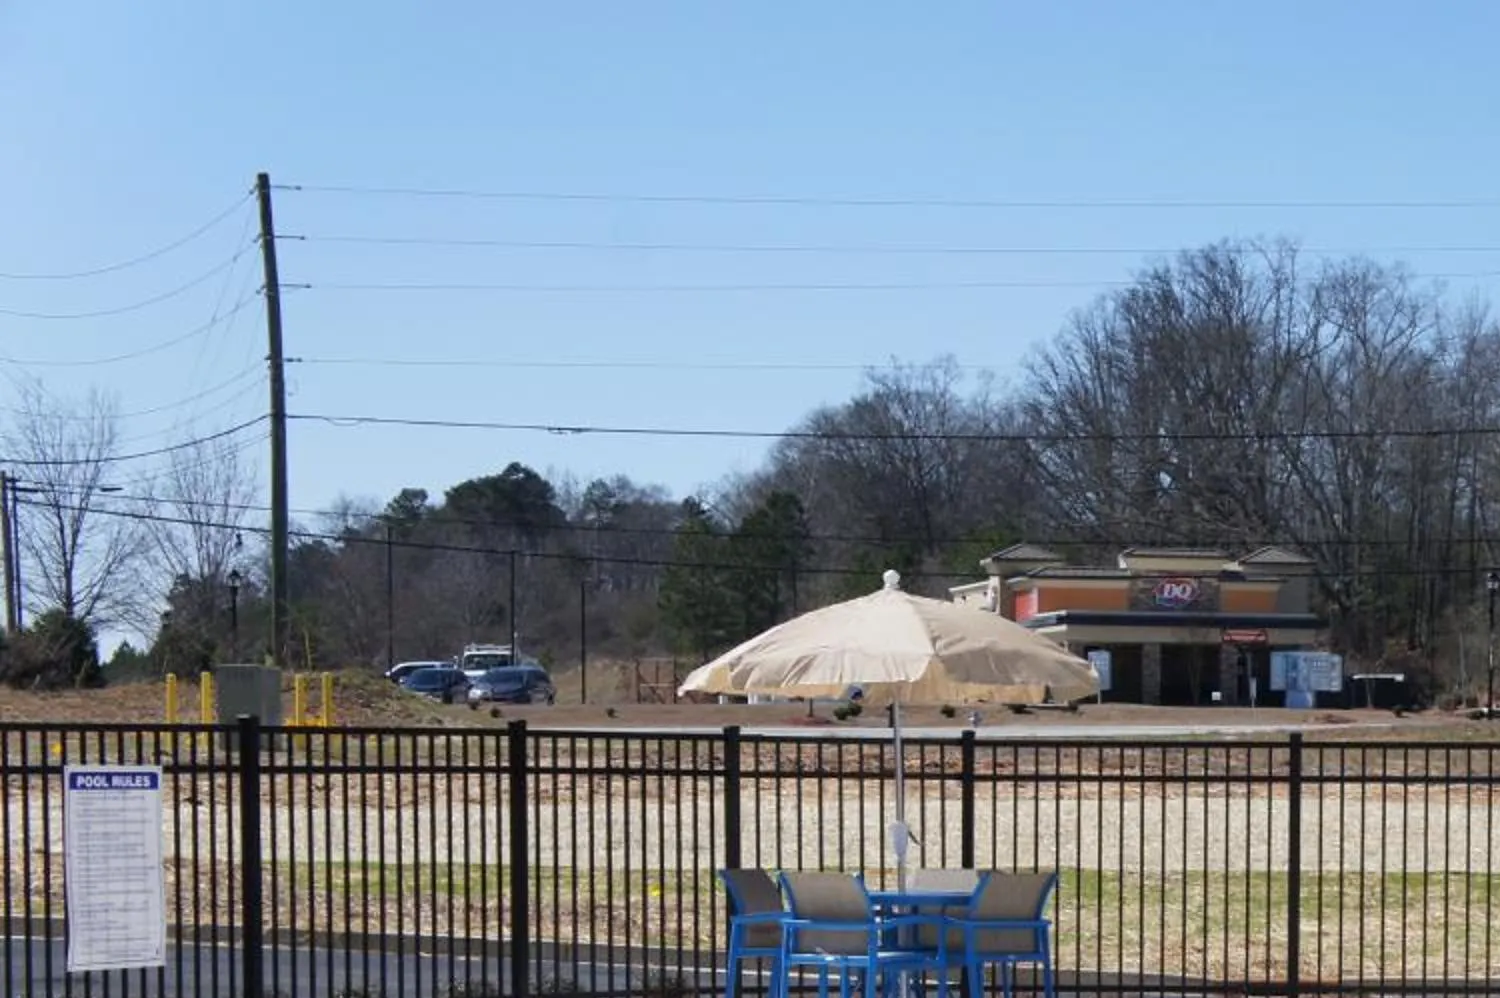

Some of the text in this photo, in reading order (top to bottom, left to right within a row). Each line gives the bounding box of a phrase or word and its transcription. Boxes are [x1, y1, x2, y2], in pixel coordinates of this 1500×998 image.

[1163, 583, 1192, 599] DQ
[76, 775, 151, 787] POOL RULES
